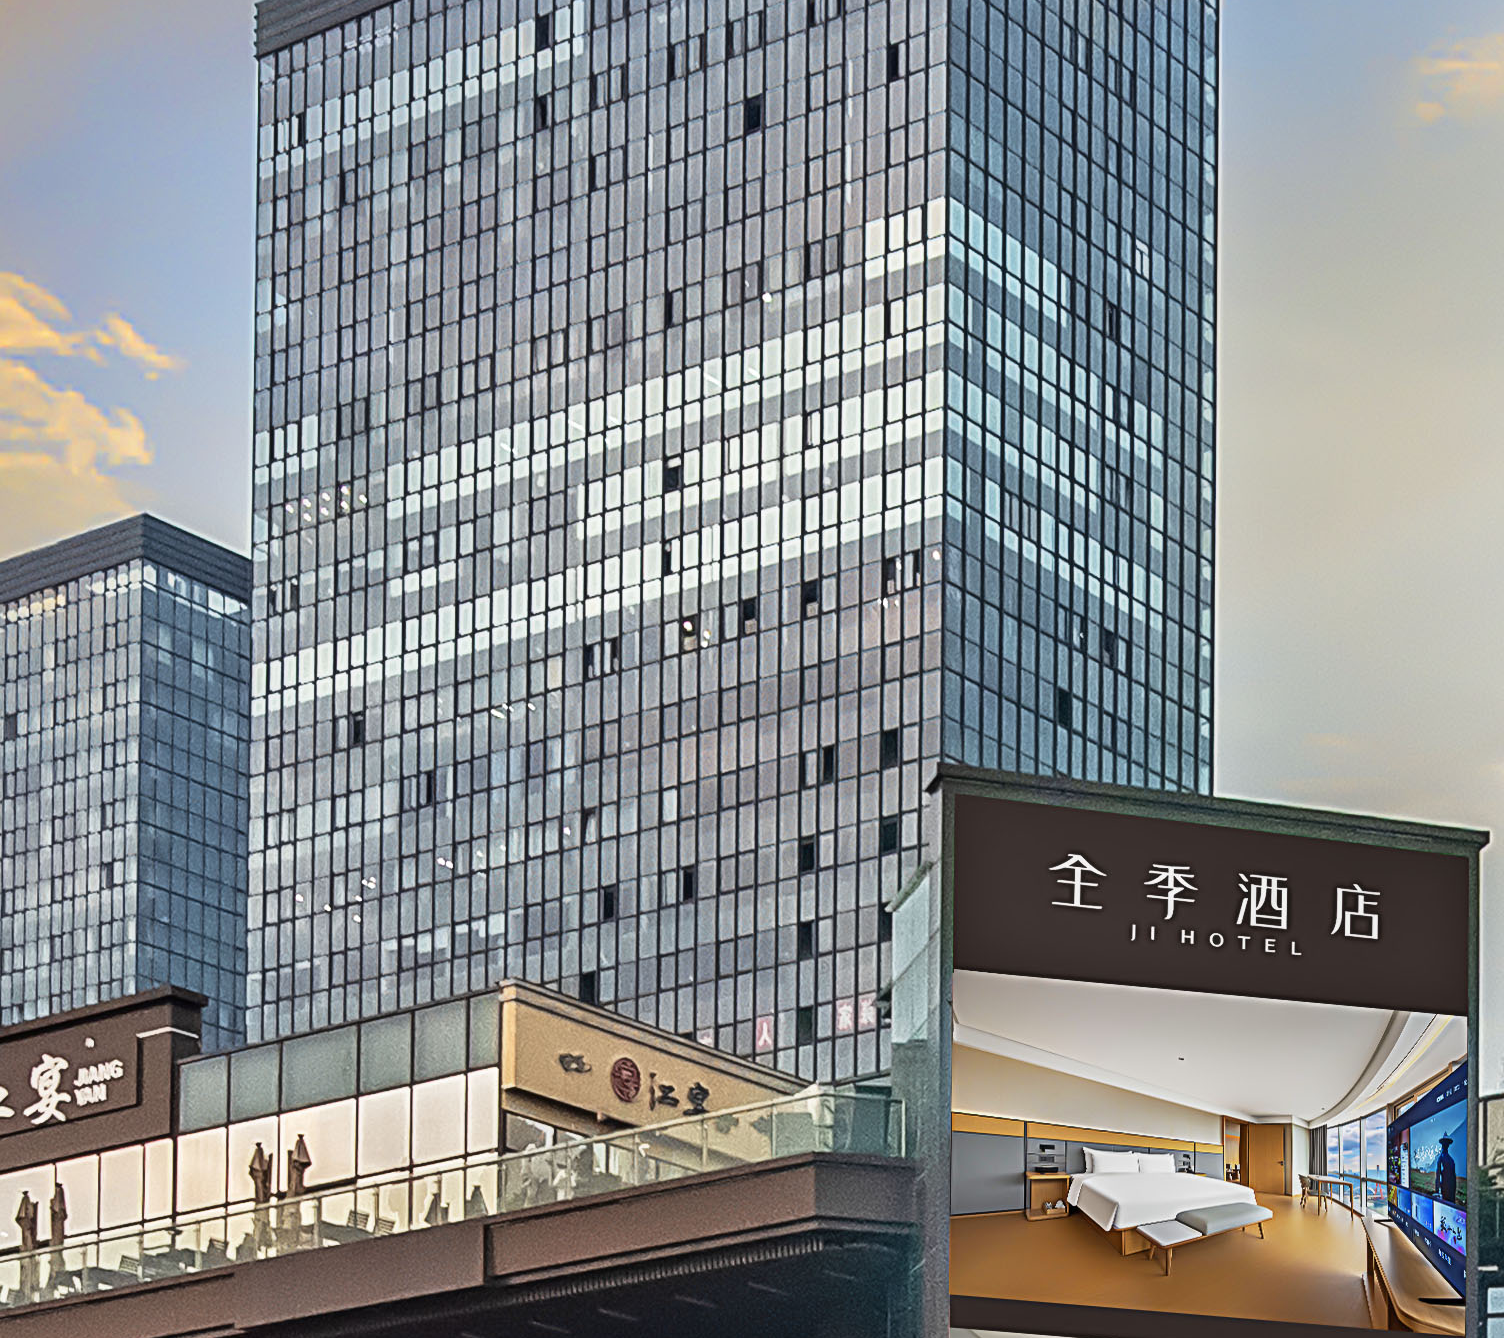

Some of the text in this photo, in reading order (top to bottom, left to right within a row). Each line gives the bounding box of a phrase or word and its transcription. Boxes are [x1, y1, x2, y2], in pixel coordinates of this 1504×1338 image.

[1049, 853, 1381, 940] 全季酒店
[1131, 924, 1303, 956] JI HOTEL
[73, 1060, 124, 1086] JIANG
